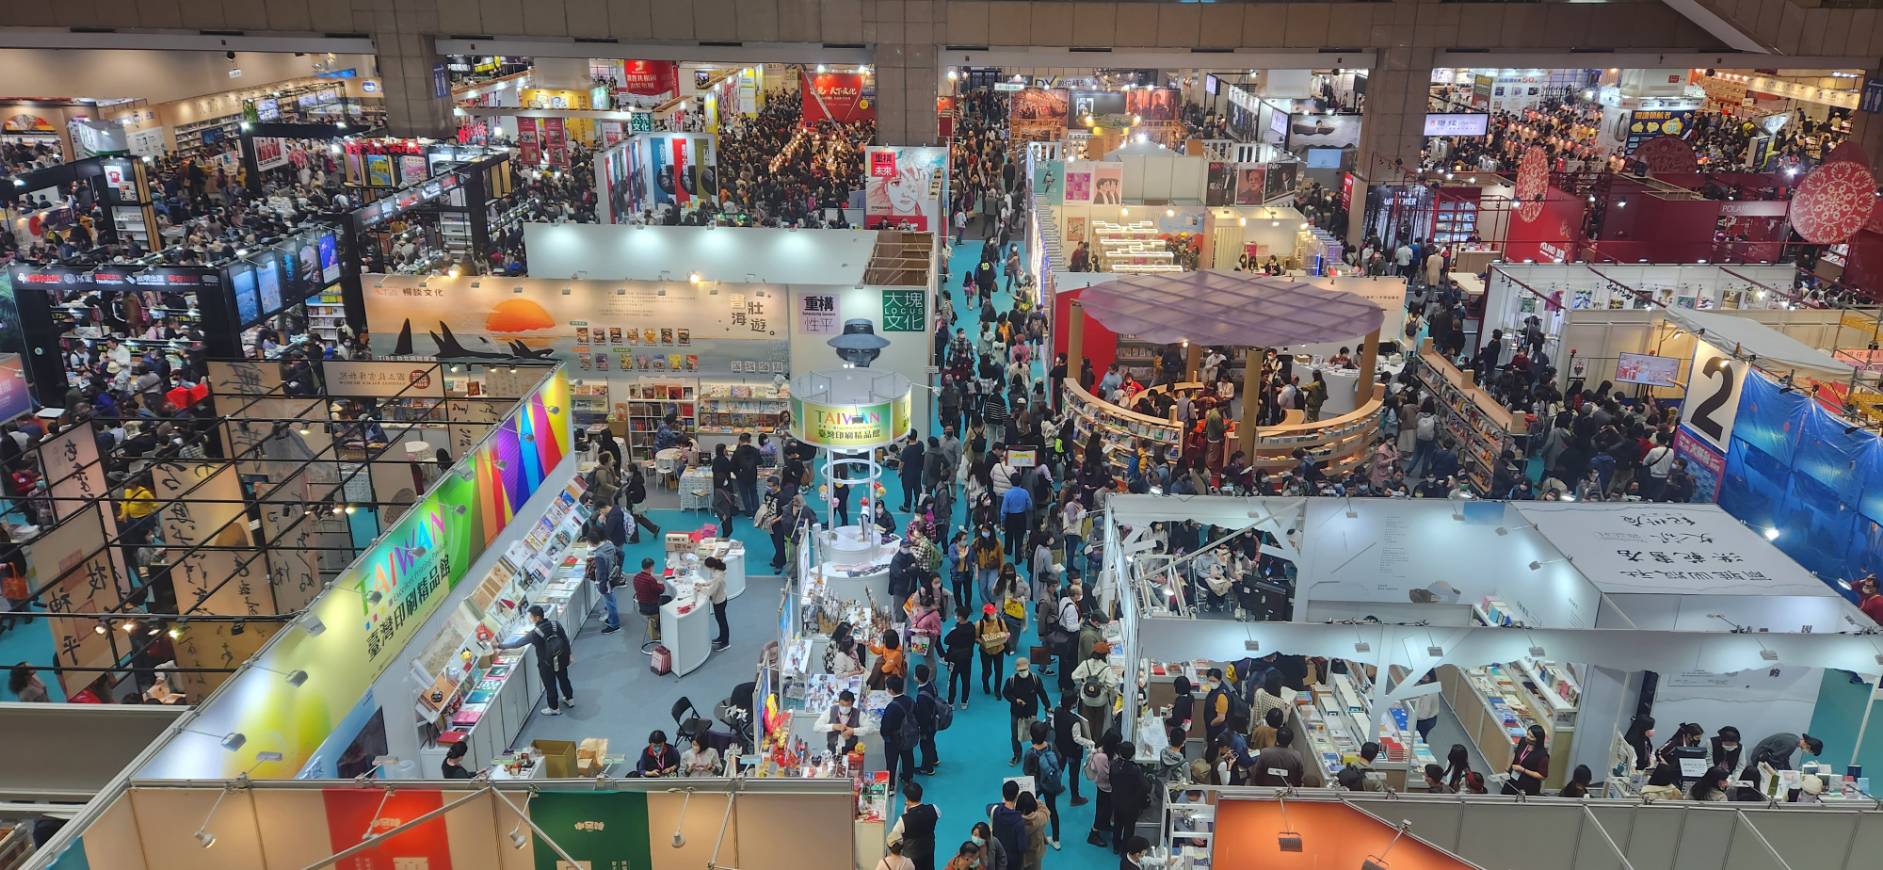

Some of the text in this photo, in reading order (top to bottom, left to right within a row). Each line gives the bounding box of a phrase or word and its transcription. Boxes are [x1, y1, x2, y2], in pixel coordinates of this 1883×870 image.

[804, 296, 834, 312] 重構
[884, 291, 924, 308] 大塊
[884, 307, 924, 315] LOCUS
[804, 317, 834, 332] 性平
[884, 315, 924, 331] 文化
[1690, 356, 1734, 441] 2
[816, 410, 880, 425] TAIWAN
[354, 505, 447, 616] TAIWAN
[366, 553, 451, 663] 臺灣印刷精品館
